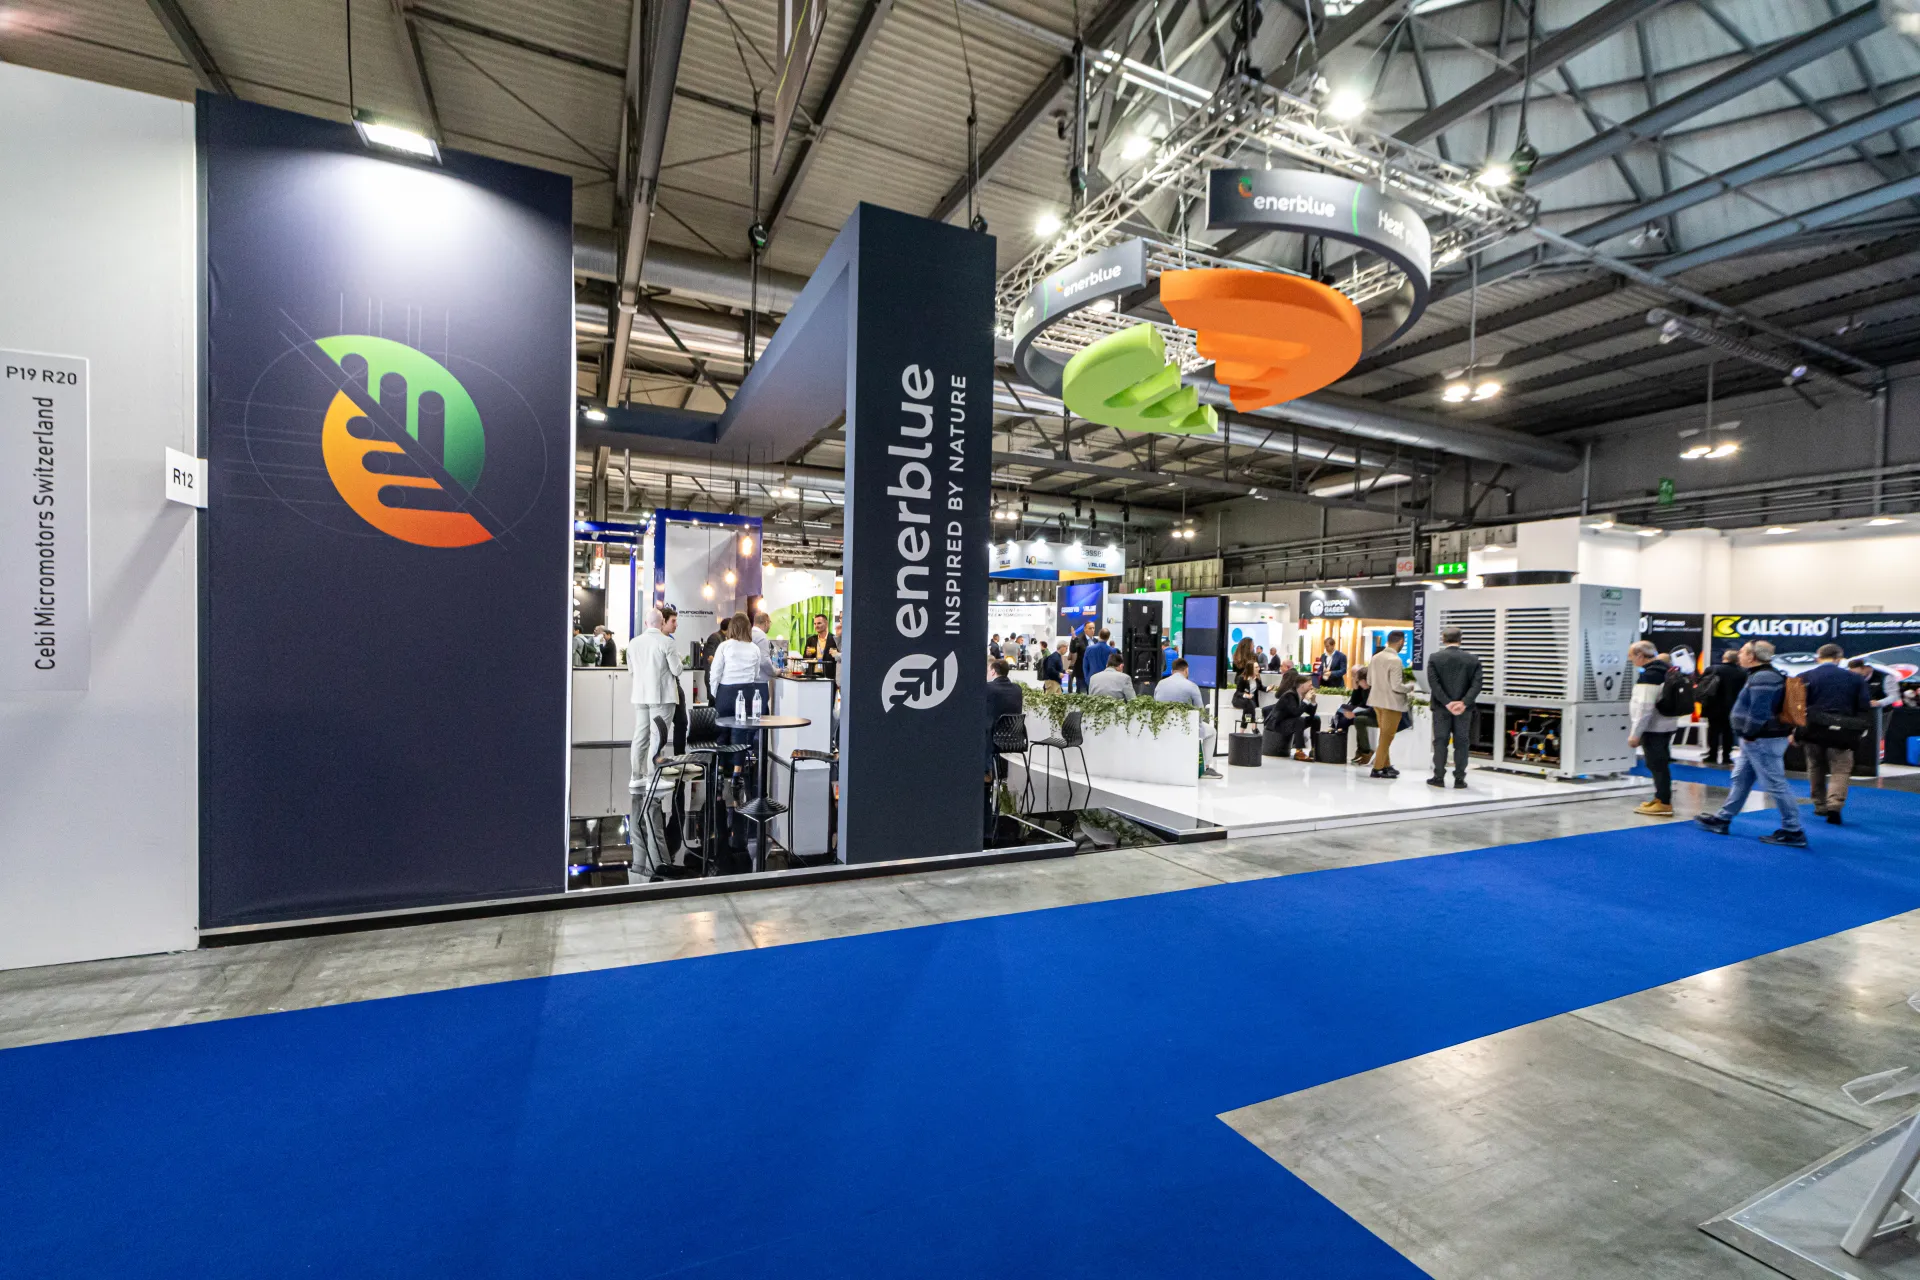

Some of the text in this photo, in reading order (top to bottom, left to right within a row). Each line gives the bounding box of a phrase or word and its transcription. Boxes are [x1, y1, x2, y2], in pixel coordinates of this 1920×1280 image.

[1253, 195, 1336, 218] enerblue
[1378, 210, 1405, 240] Heat
[1063, 265, 1122, 297] enerblue
[6, 365, 77, 386] P19 R20
[173, 467, 193, 489] R12
[886, 363, 935, 639] enerblue
[944, 373, 967, 636] INSPIRED BY NATURE
[32, 396, 56, 670] Cebi Micromotors Switzerland
[1397, 561, 1413, 572] 9G
[1413, 609, 1424, 664] PALLADIUM
[1736, 618, 1830, 637] CALECTRO
